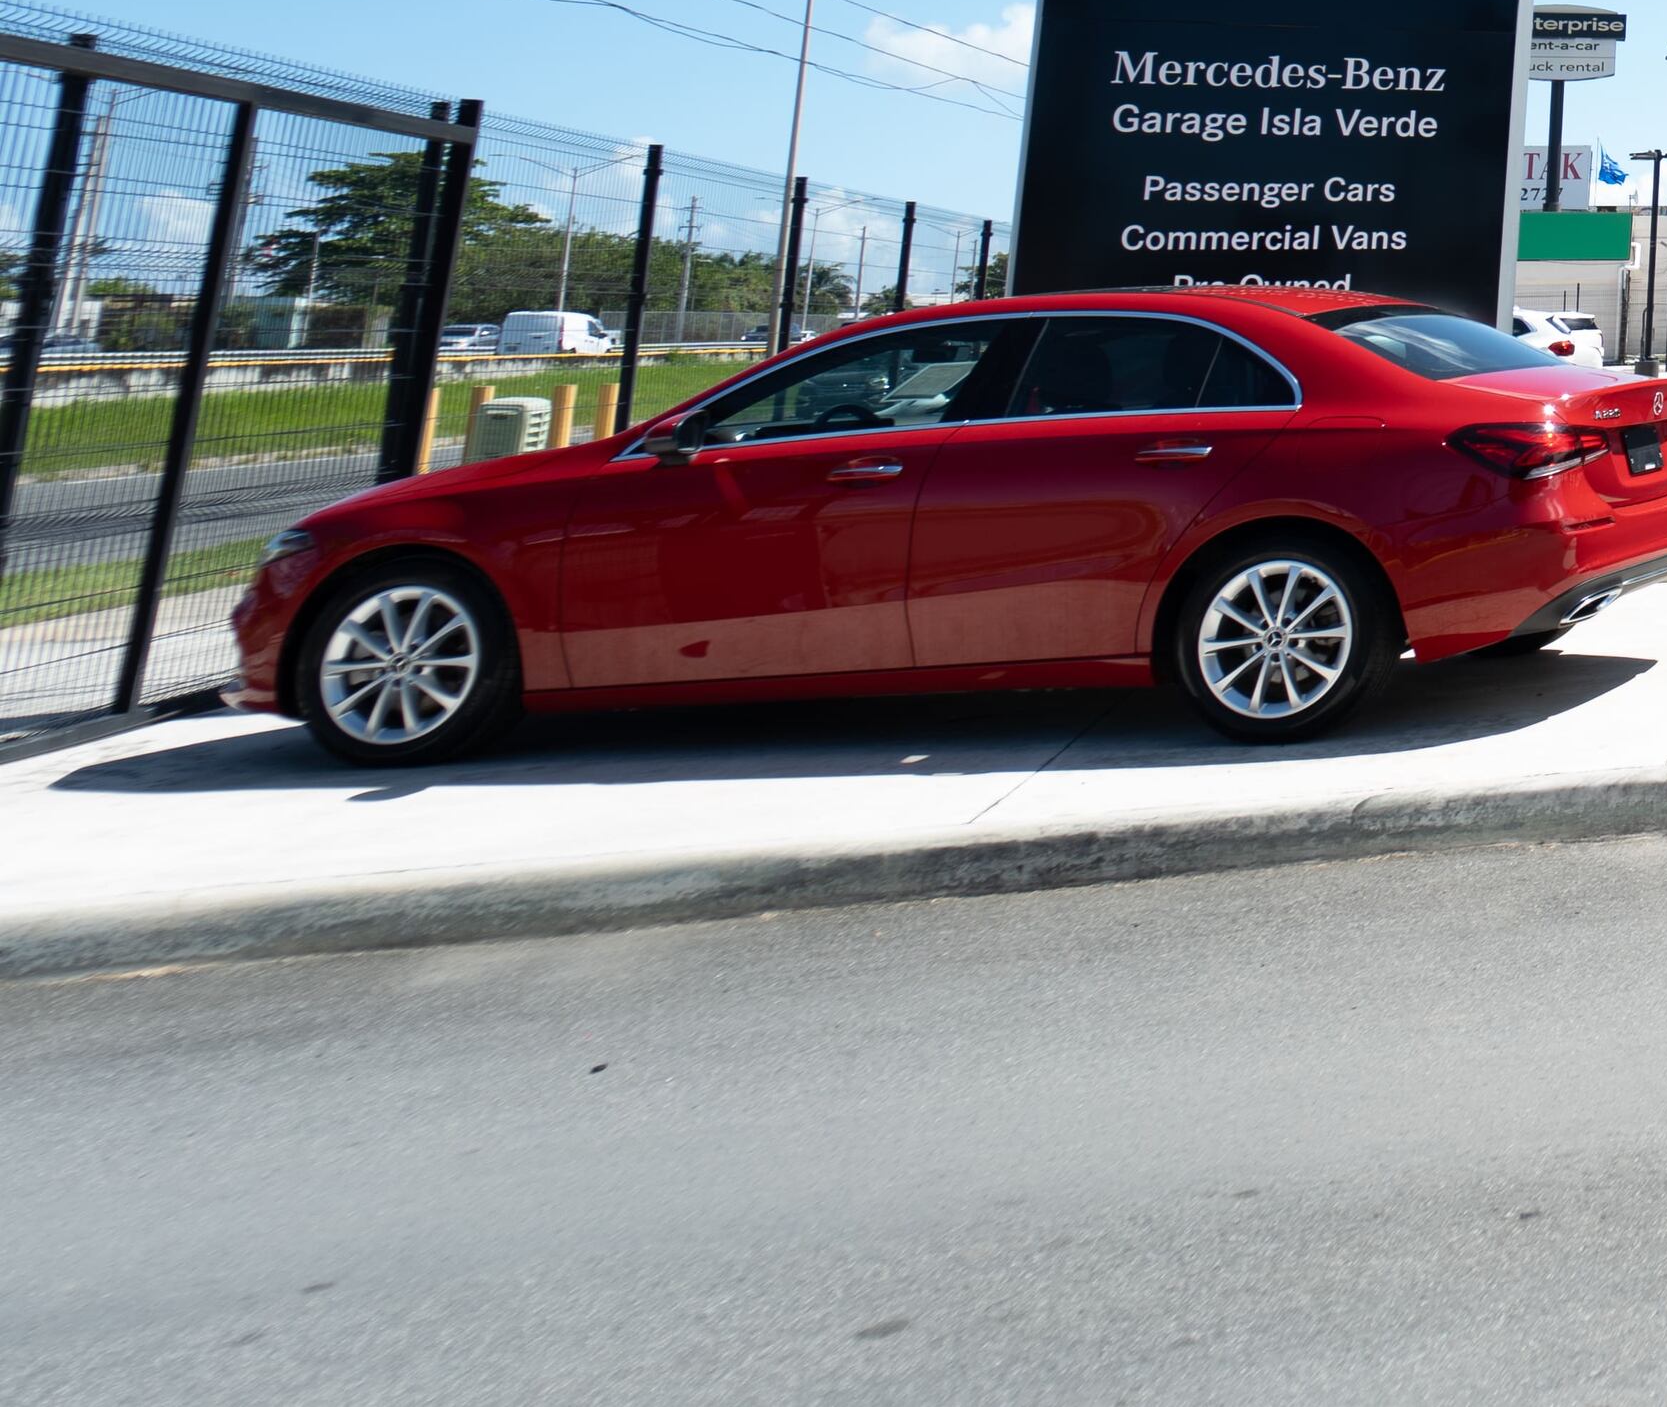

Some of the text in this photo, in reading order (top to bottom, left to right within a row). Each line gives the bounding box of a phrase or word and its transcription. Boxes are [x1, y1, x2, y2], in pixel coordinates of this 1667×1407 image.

[1534, 17, 1625, 34] terprise
[1531, 41, 1601, 51] ent-a-car
[1110, 50, 1446, 92] Mercedes-Benz
[1530, 61, 1605, 72] uck rental
[1112, 103, 1438, 142] Garage Isla Verde
[1143, 175, 1396, 209] Passenger Cars
[1520, 187, 1563, 201] 272
[1121, 224, 1407, 251] Commercial Vans
[1173, 274, 1352, 291] POned
